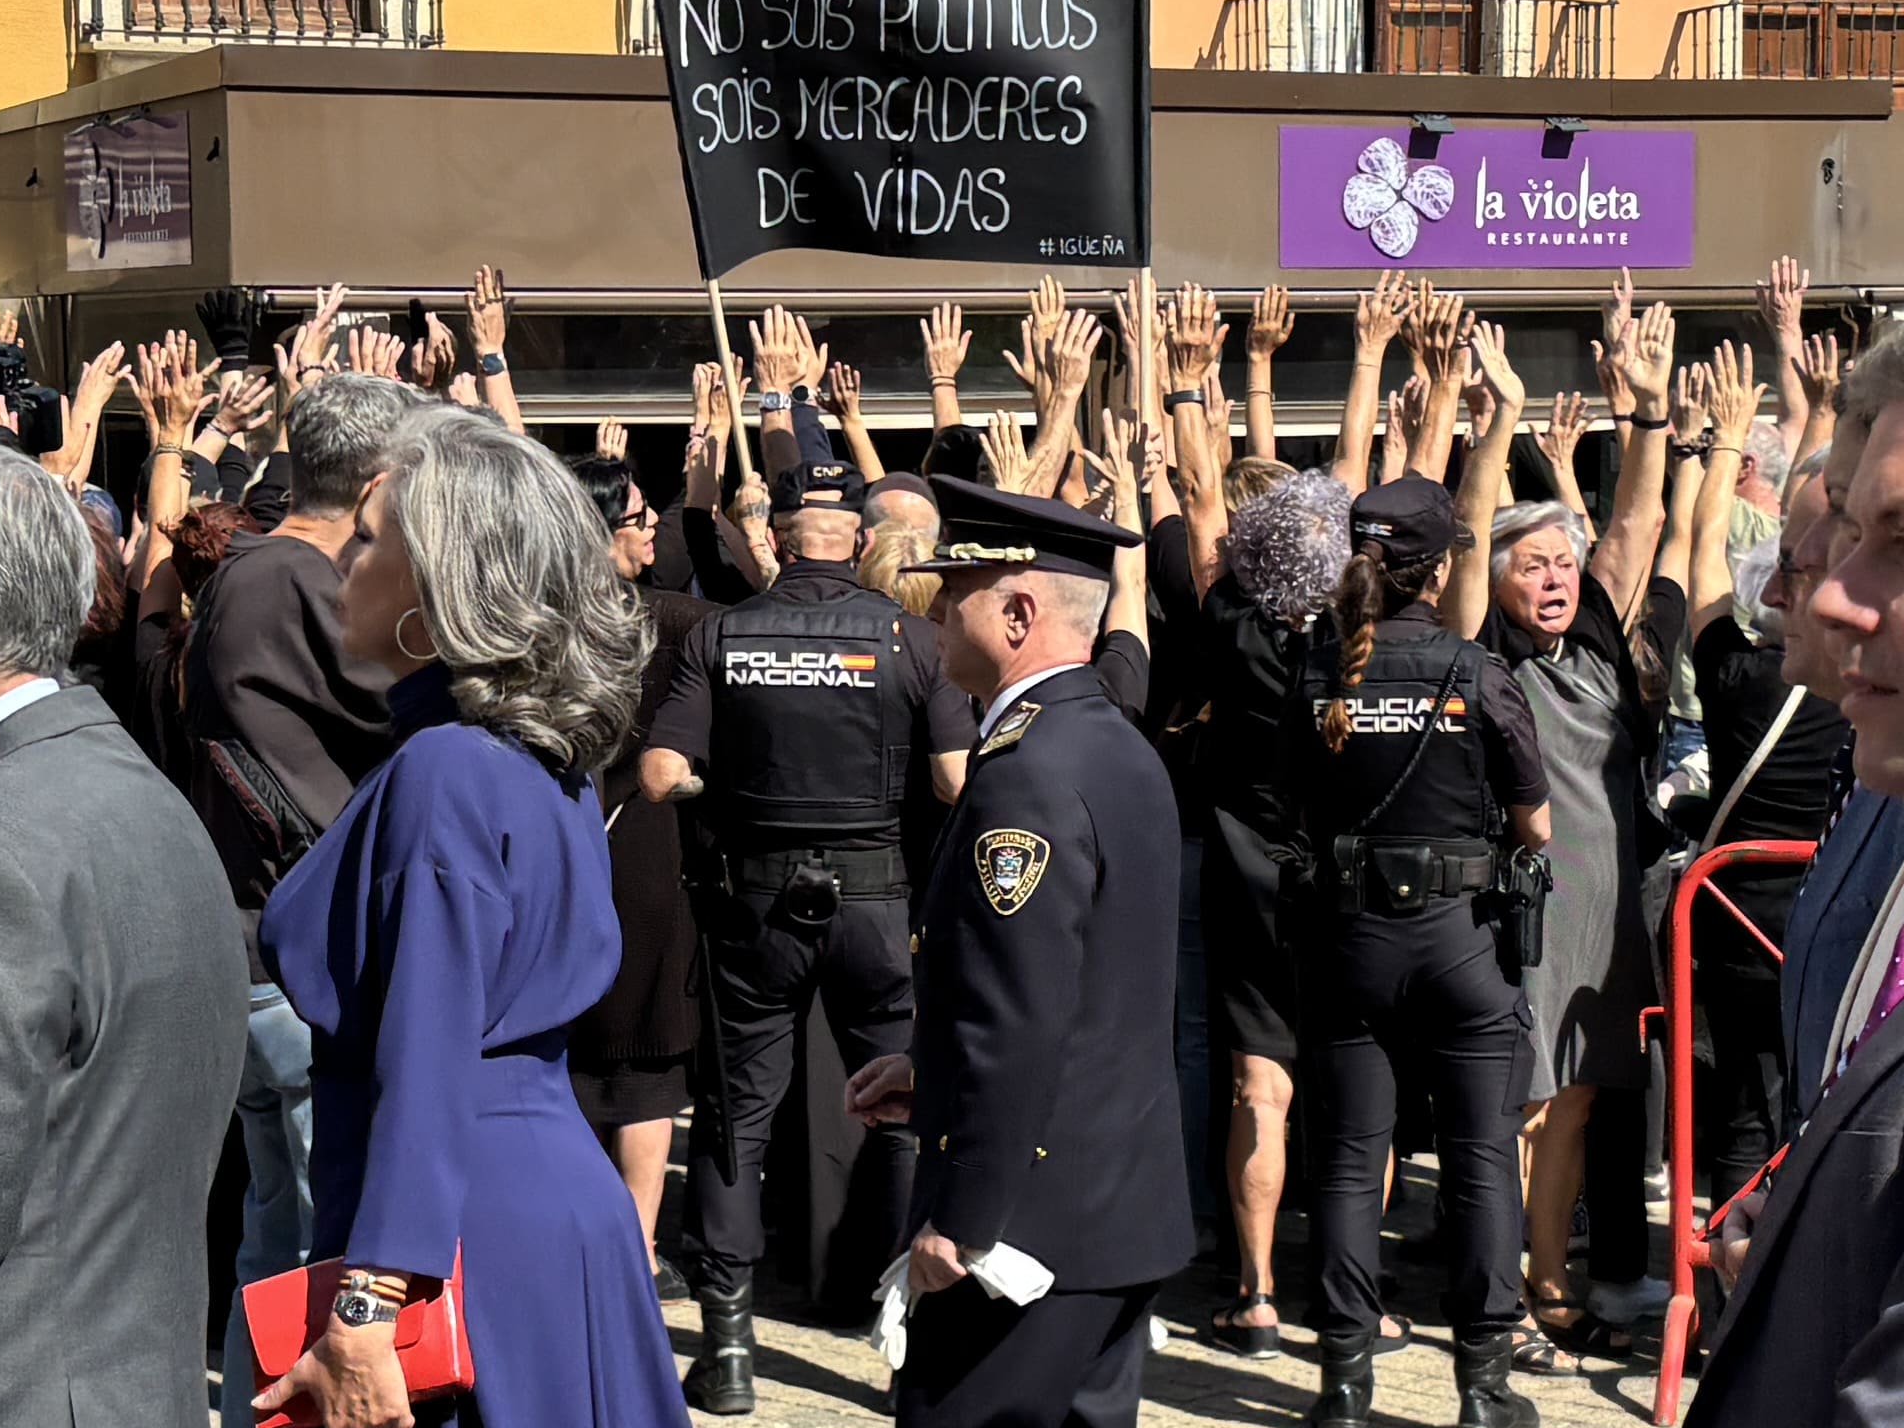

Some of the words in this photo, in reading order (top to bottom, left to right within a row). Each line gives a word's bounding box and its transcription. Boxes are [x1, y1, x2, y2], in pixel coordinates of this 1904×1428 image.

[693, 67, 781, 153] SOIS
[794, 75, 1088, 146] MERCADERES
[757, 167, 817, 229] DE
[854, 156, 1010, 236] VIDAS
[1474, 155, 1506, 229] la
[1519, 156, 1641, 229] violeta
[1487, 231, 1630, 246] RESTAURANTE
[812, 465, 844, 478] CNP
[725, 651, 845, 670] POLICIA
[725, 668, 876, 688] NACIONAL
